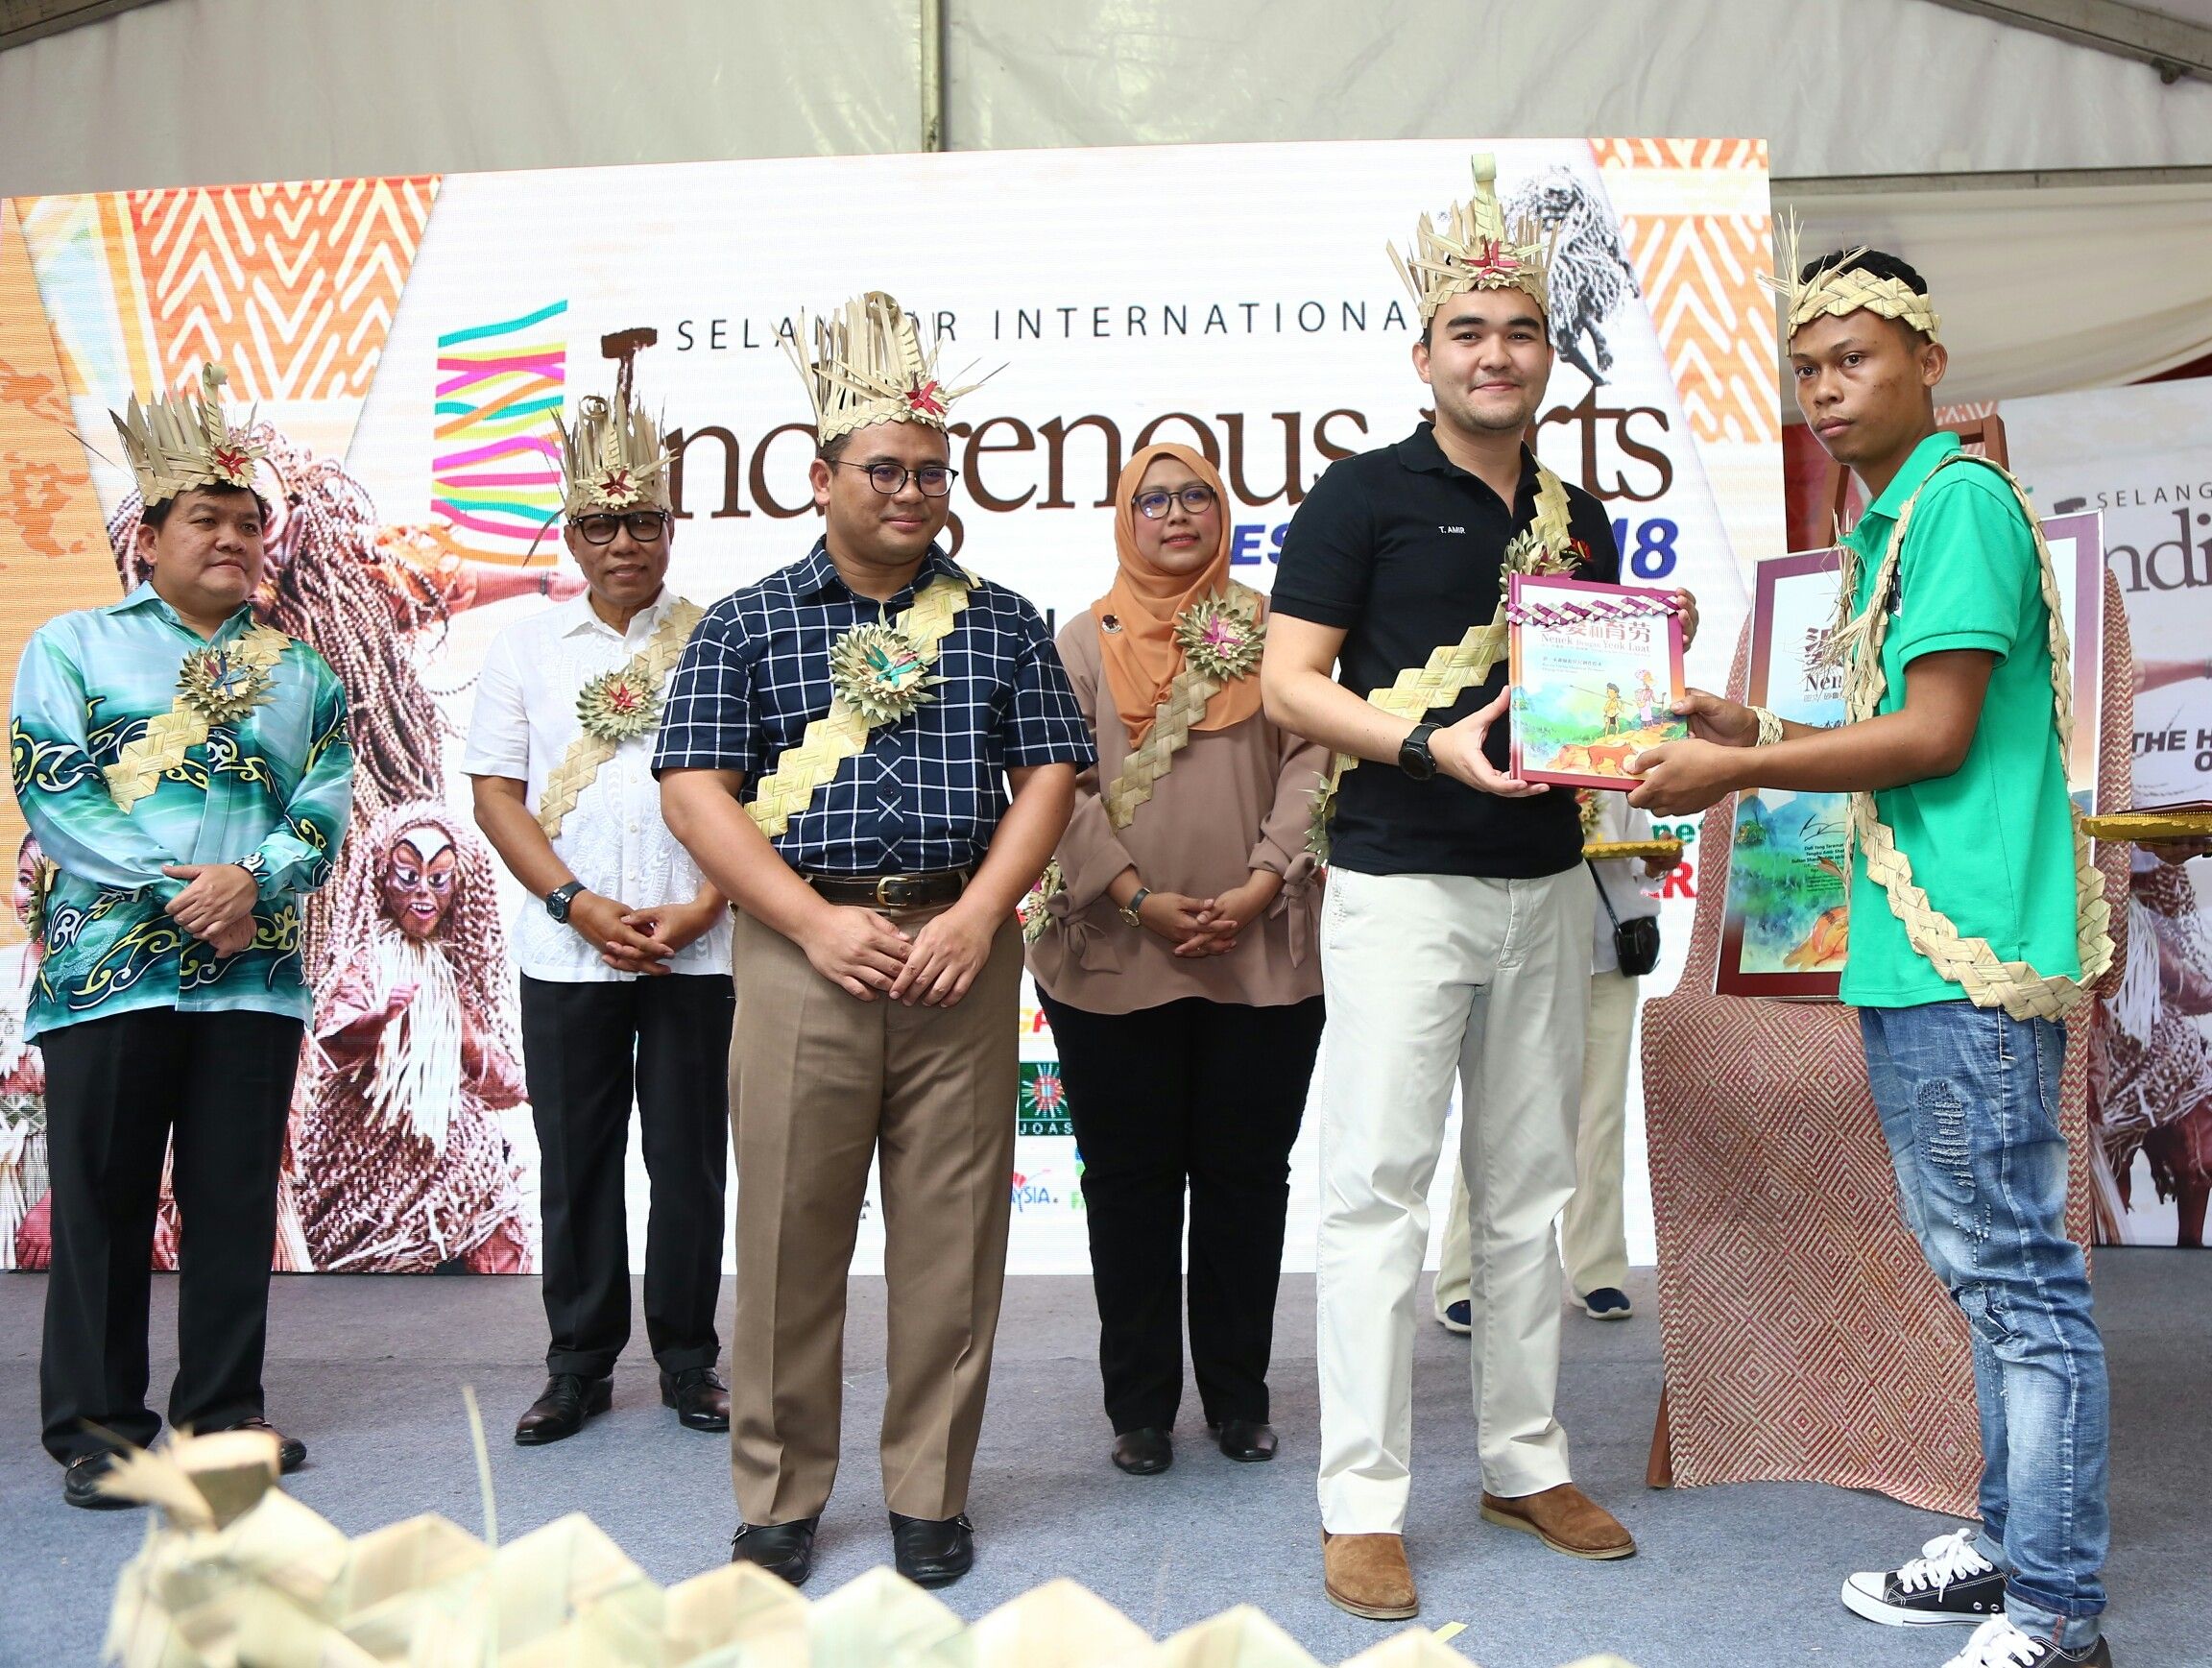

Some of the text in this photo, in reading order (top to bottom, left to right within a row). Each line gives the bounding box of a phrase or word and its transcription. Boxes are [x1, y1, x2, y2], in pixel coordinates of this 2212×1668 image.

[2104, 507, 2212, 594] ndi
[2132, 730, 2188, 753] THE
[1020, 1122, 1073, 1135] JOAS
